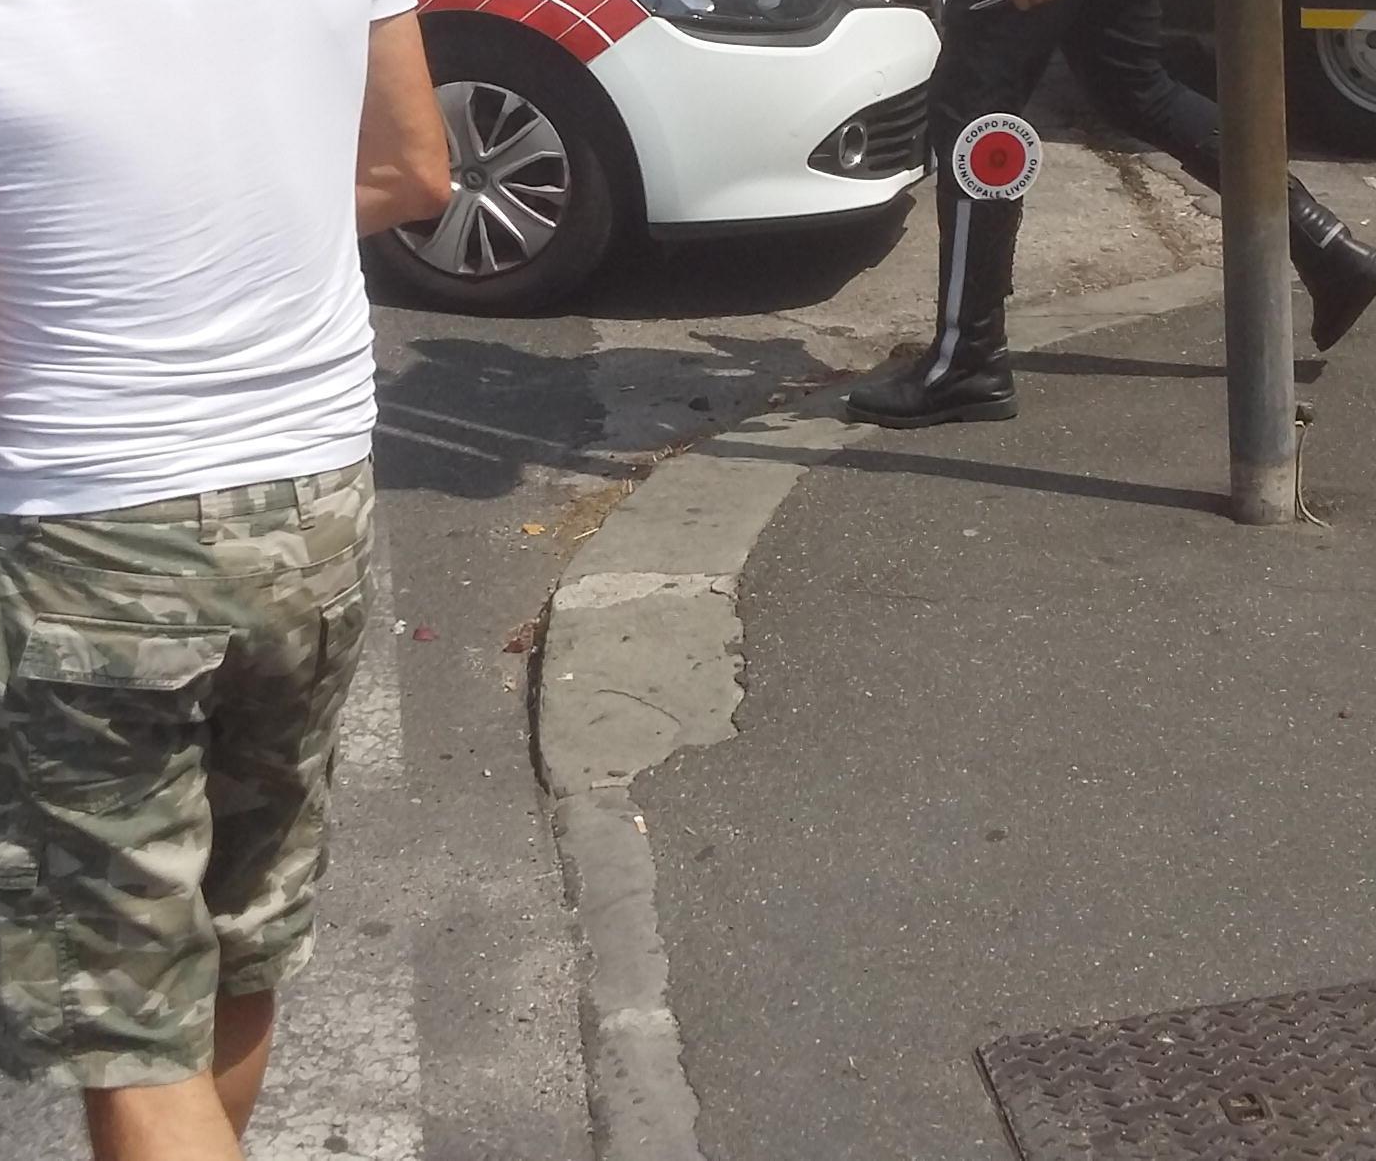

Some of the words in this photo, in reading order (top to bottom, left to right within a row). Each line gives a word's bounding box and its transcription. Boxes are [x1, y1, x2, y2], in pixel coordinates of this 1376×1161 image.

[965, 120, 999, 144] CORPO
[1002, 120, 1034, 147] POLIZIA
[958, 154, 1001, 199] MUNICIPALE
[1004, 159, 1038, 196] LIVORNO
